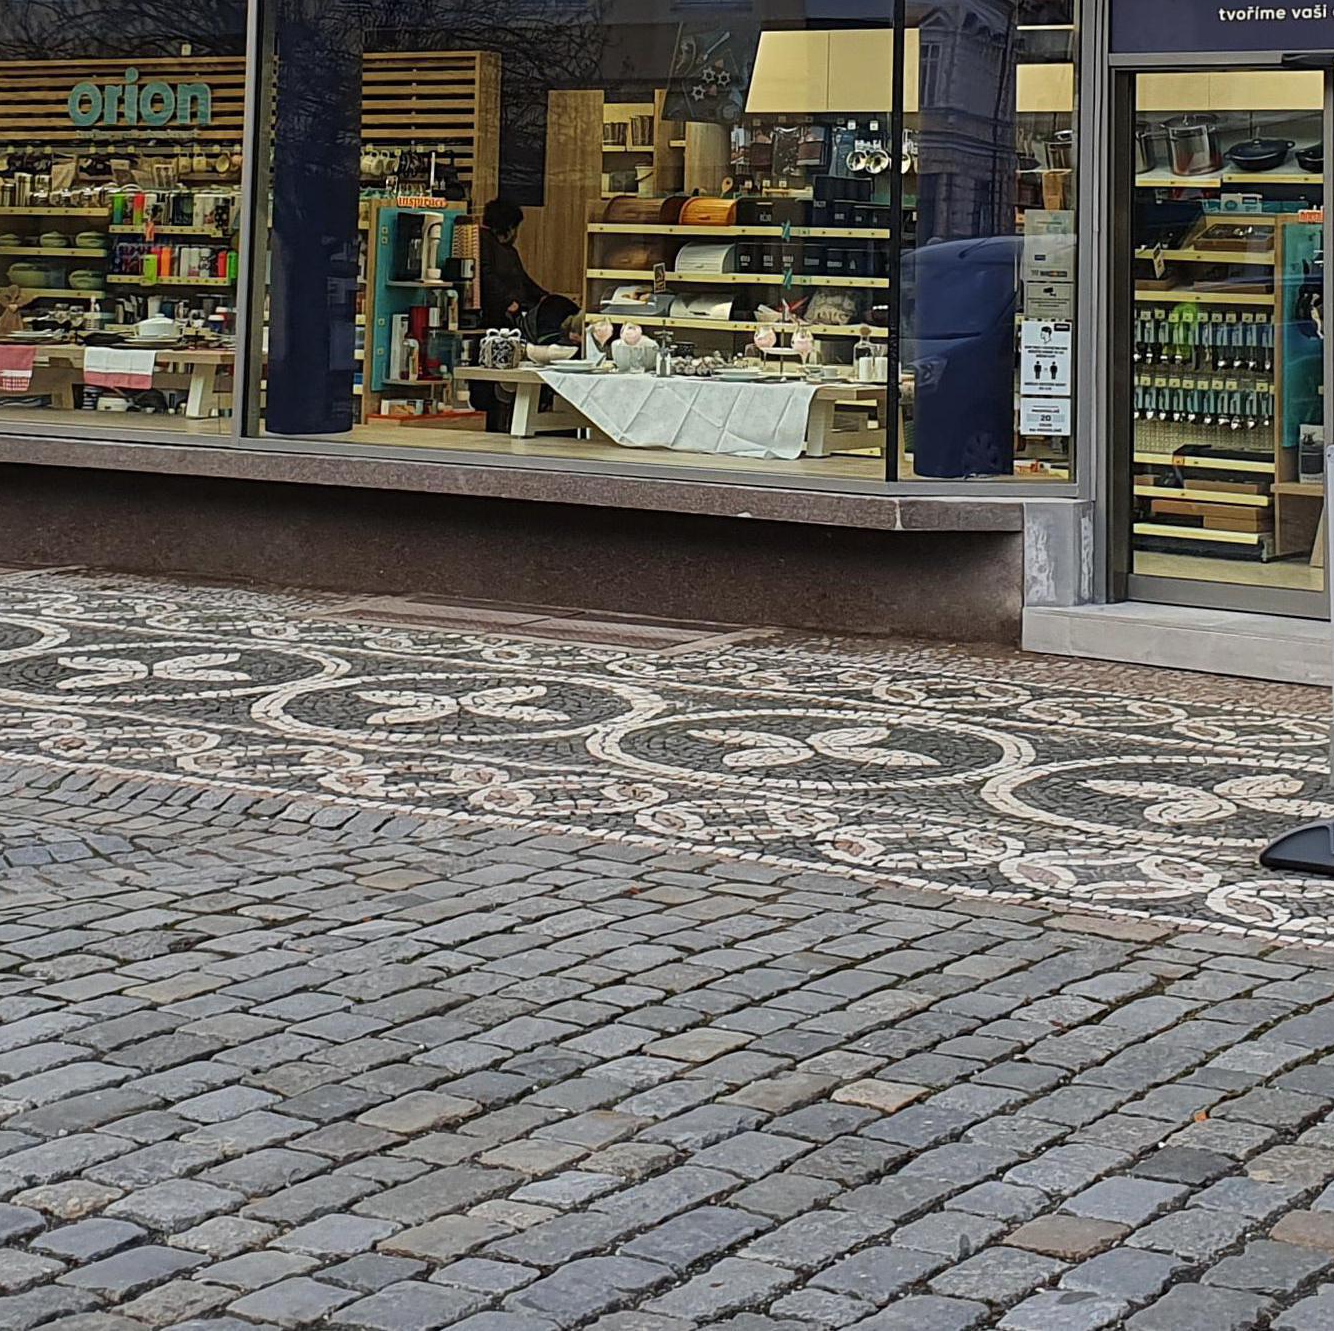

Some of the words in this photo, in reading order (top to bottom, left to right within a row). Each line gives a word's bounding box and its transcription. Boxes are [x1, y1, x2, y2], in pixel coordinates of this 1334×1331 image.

[1218, 6, 1286, 21] tvoříme
[1292, 4, 1327, 19] vaši
[68, 67, 212, 126] orion
